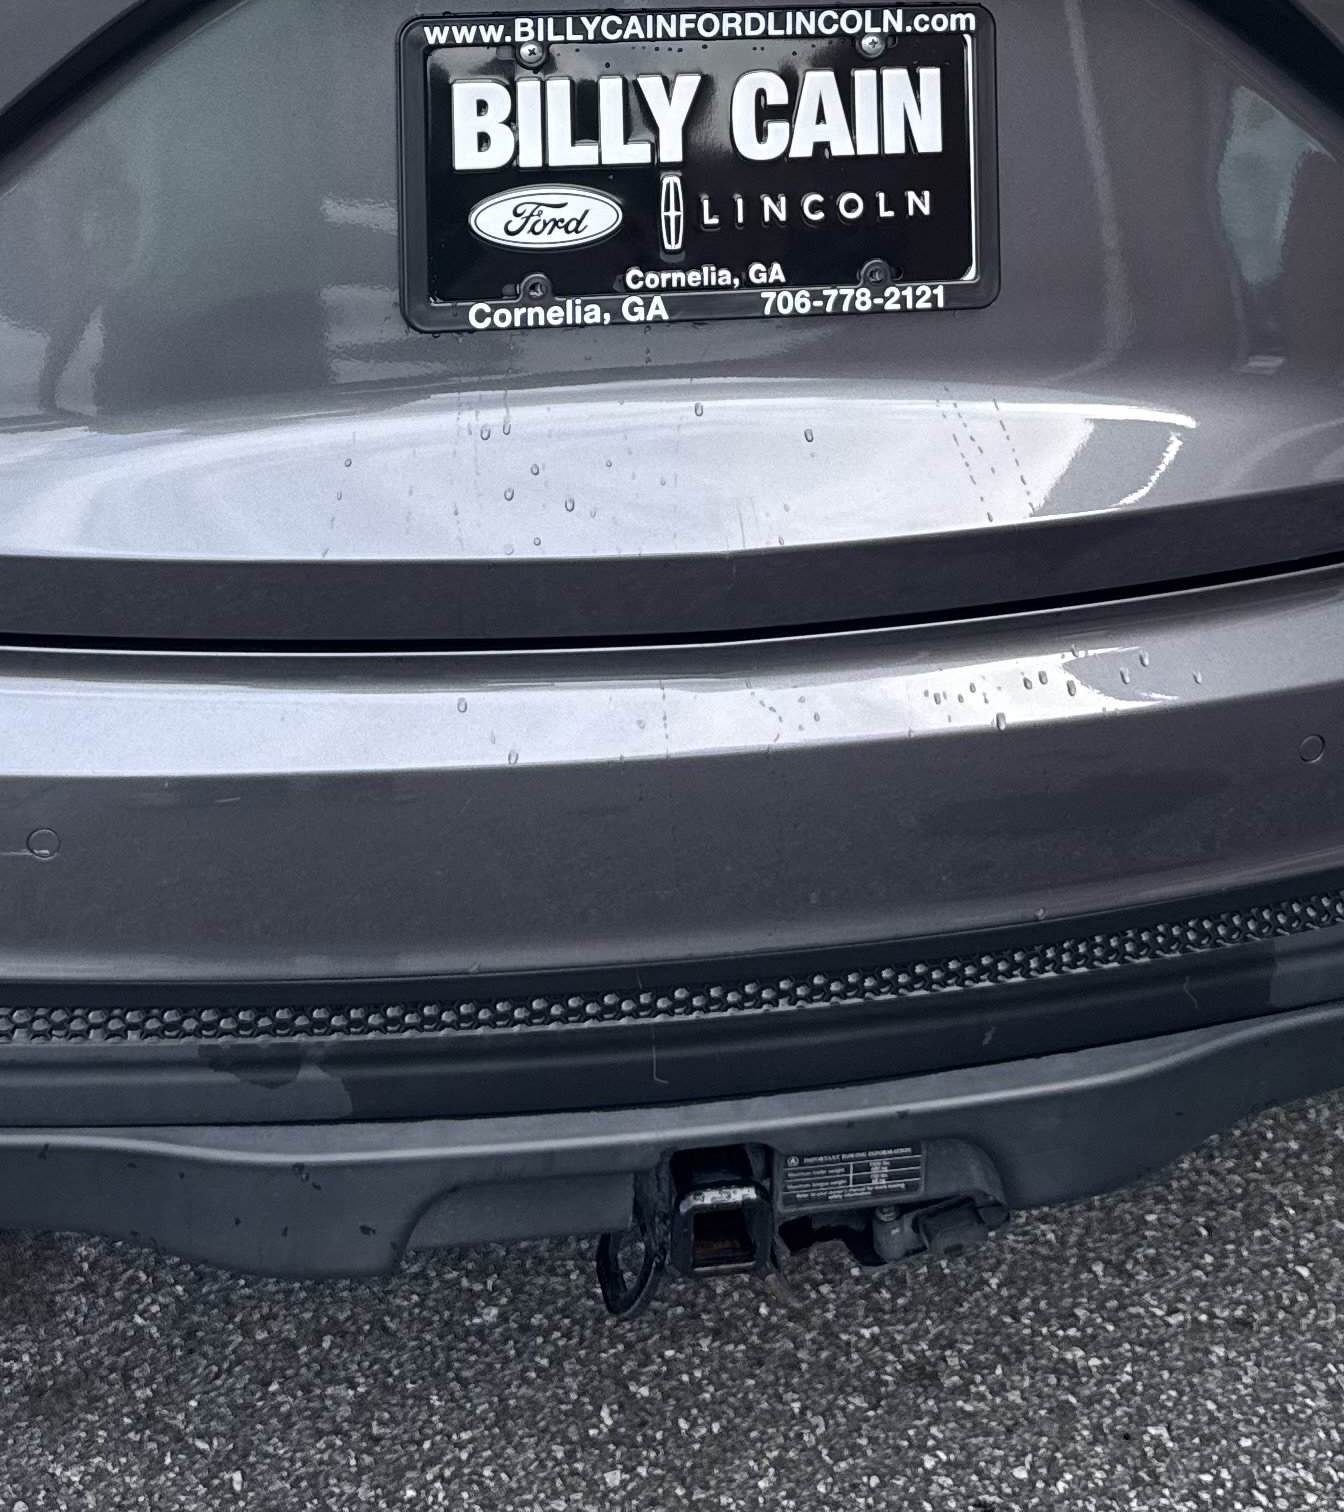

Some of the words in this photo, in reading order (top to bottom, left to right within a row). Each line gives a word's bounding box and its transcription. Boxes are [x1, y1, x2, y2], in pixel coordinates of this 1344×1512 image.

[424, 10, 976, 45] www.BILLYCAINFORDLINCOLN.com
[451, 73, 702, 170] BILLY
[730, 66, 943, 162] CAIN
[503, 201, 588, 236] Ford
[702, 190, 932, 226] LINCOLN
[625, 265, 740, 290] Cornelia,
[748, 263, 786, 285] GA
[467, 299, 612, 329] Cornelia,
[622, 296, 670, 322] GA
[760, 285, 945, 317] 706-778-2121
